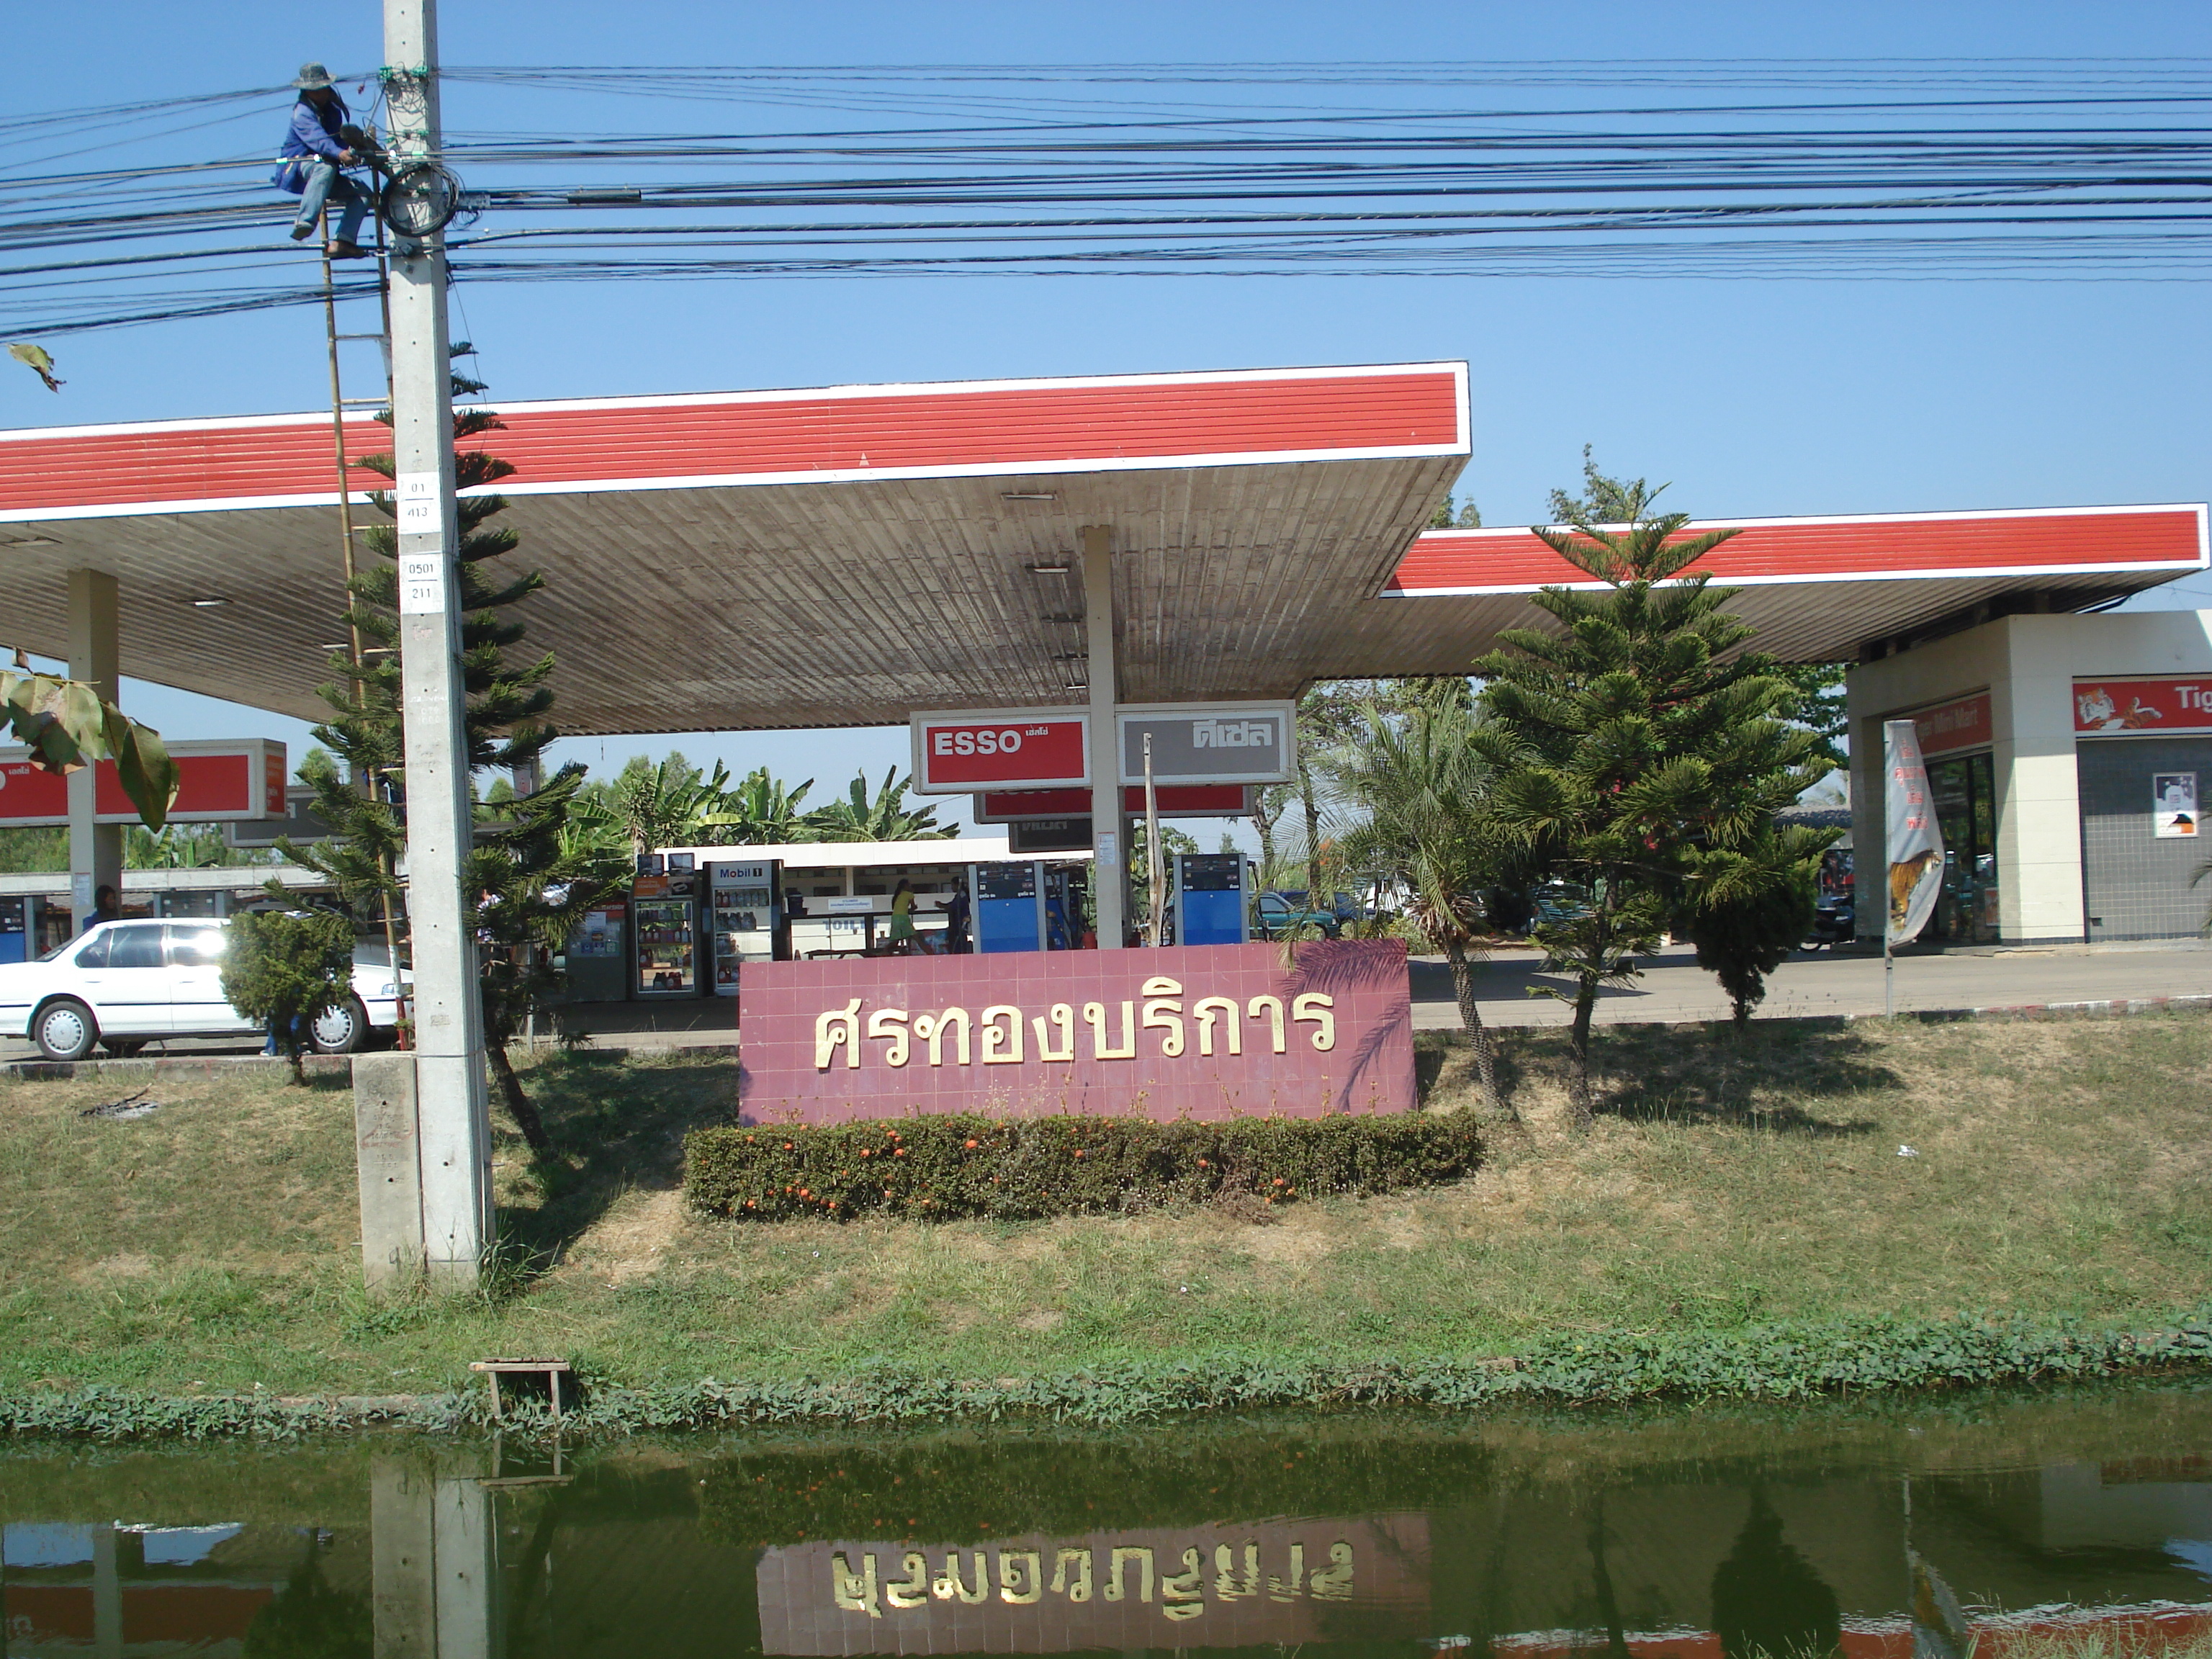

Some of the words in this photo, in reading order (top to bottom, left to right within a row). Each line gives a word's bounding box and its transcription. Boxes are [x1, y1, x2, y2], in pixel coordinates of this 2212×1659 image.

[411, 483, 426, 493] 01
[409, 564, 433, 574] 0501
[412, 588, 431, 599] 211
[1192, 719, 1272, 749] ดีเซล
[934, 729, 1022, 756] ESSO
[720, 868, 750, 878] Mobil
[815, 976, 1336, 1071] ศรทองบริการ
